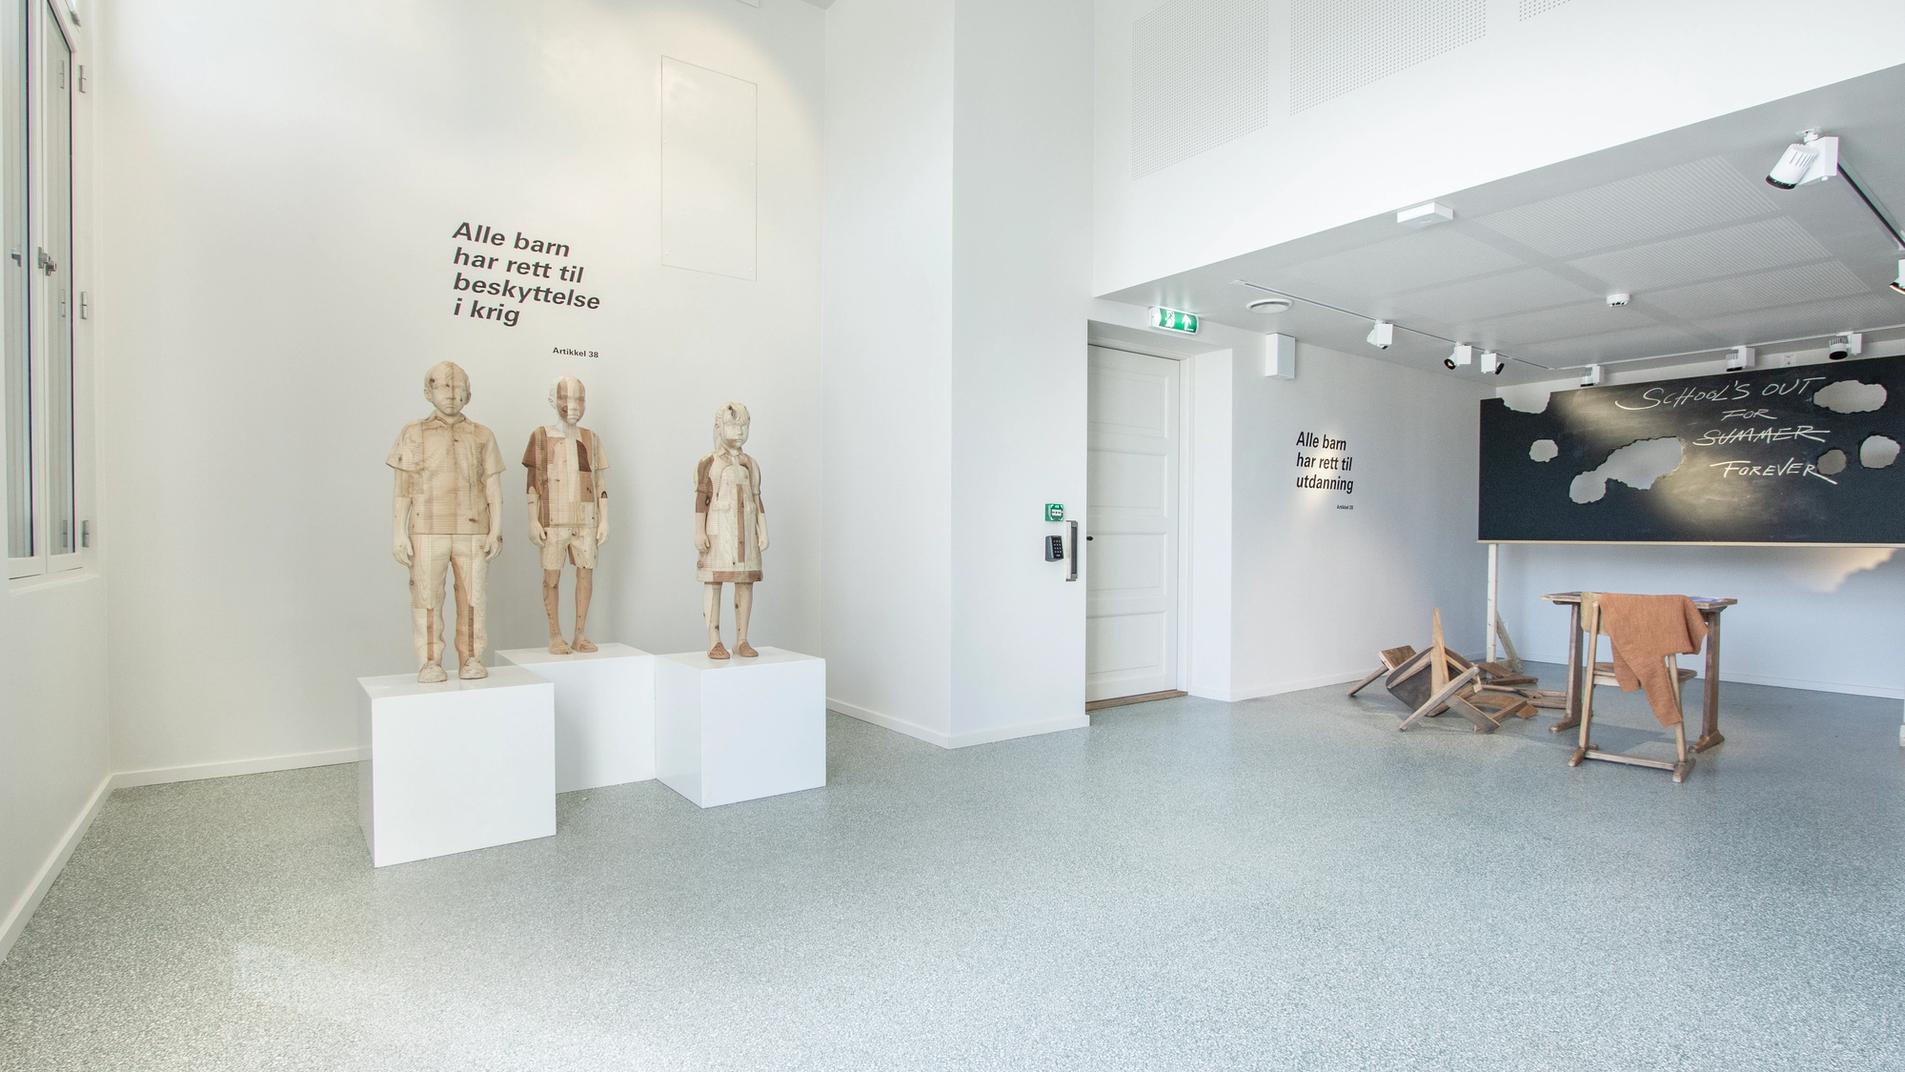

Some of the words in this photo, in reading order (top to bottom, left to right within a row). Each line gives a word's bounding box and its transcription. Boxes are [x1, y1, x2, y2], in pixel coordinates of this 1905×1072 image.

[451, 221, 506, 247] Alle
[513, 231, 570, 258] barn
[453, 246, 500, 270] har
[505, 259, 553, 279] rett
[559, 265, 585, 284] til
[453, 271, 601, 310] beskyttelse
[453, 297, 463, 316] i
[469, 299, 521, 328] krig
[552, 346, 587, 358] Artikkel
[588, 350, 599, 359] 38
[1761, 376, 1827, 397] OUT
[1720, 408, 1778, 422] FOR
[1296, 431, 1320, 448] Alle
[1322, 433, 1347, 451] barn
[1692, 425, 1831, 447] SUMMER
[1296, 452, 1317, 468] har
[1318, 457, 1339, 470] rett
[1341, 456, 1353, 472] til
[1709, 457, 1839, 485] FOREVER
[1296, 474, 1354, 494] utdanning
